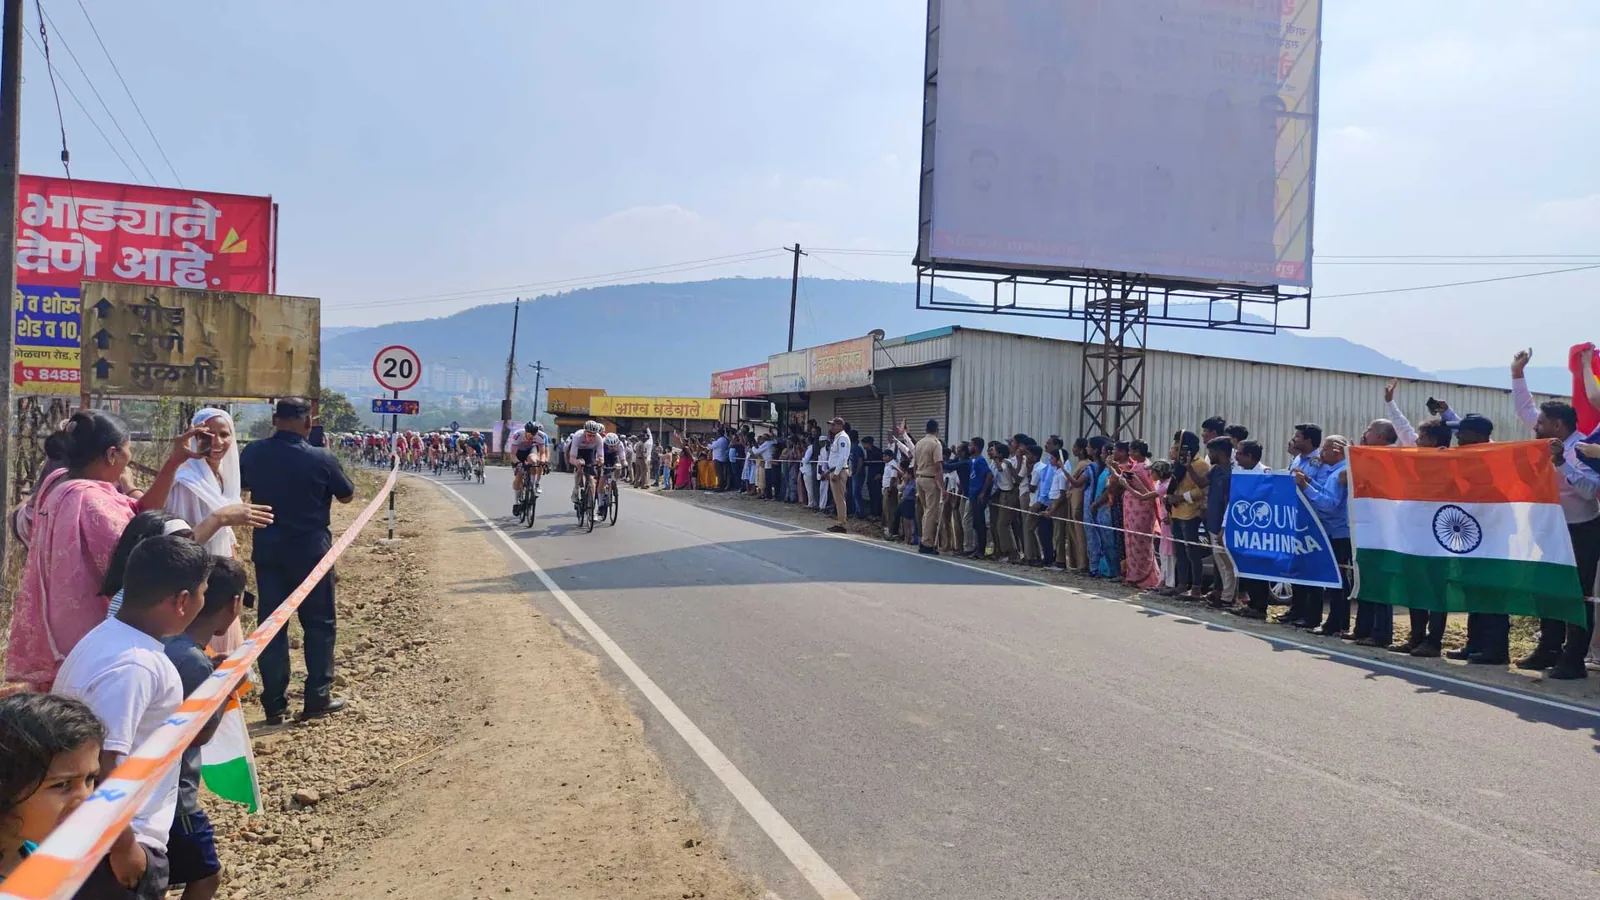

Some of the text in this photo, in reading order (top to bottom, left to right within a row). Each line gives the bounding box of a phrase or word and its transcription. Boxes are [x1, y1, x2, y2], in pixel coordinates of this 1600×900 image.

[16, 229, 222, 289] देणे आहे.
[27, 295, 40, 313] व
[17, 314, 80, 342] शेड व 10,
[39, 369, 80, 381] 8483
[383, 357, 413, 379] 20
[615, 401, 649, 416] आरव
[653, 399, 701, 417] वडेवाले
[1234, 530, 1323, 555] MAHINRA
